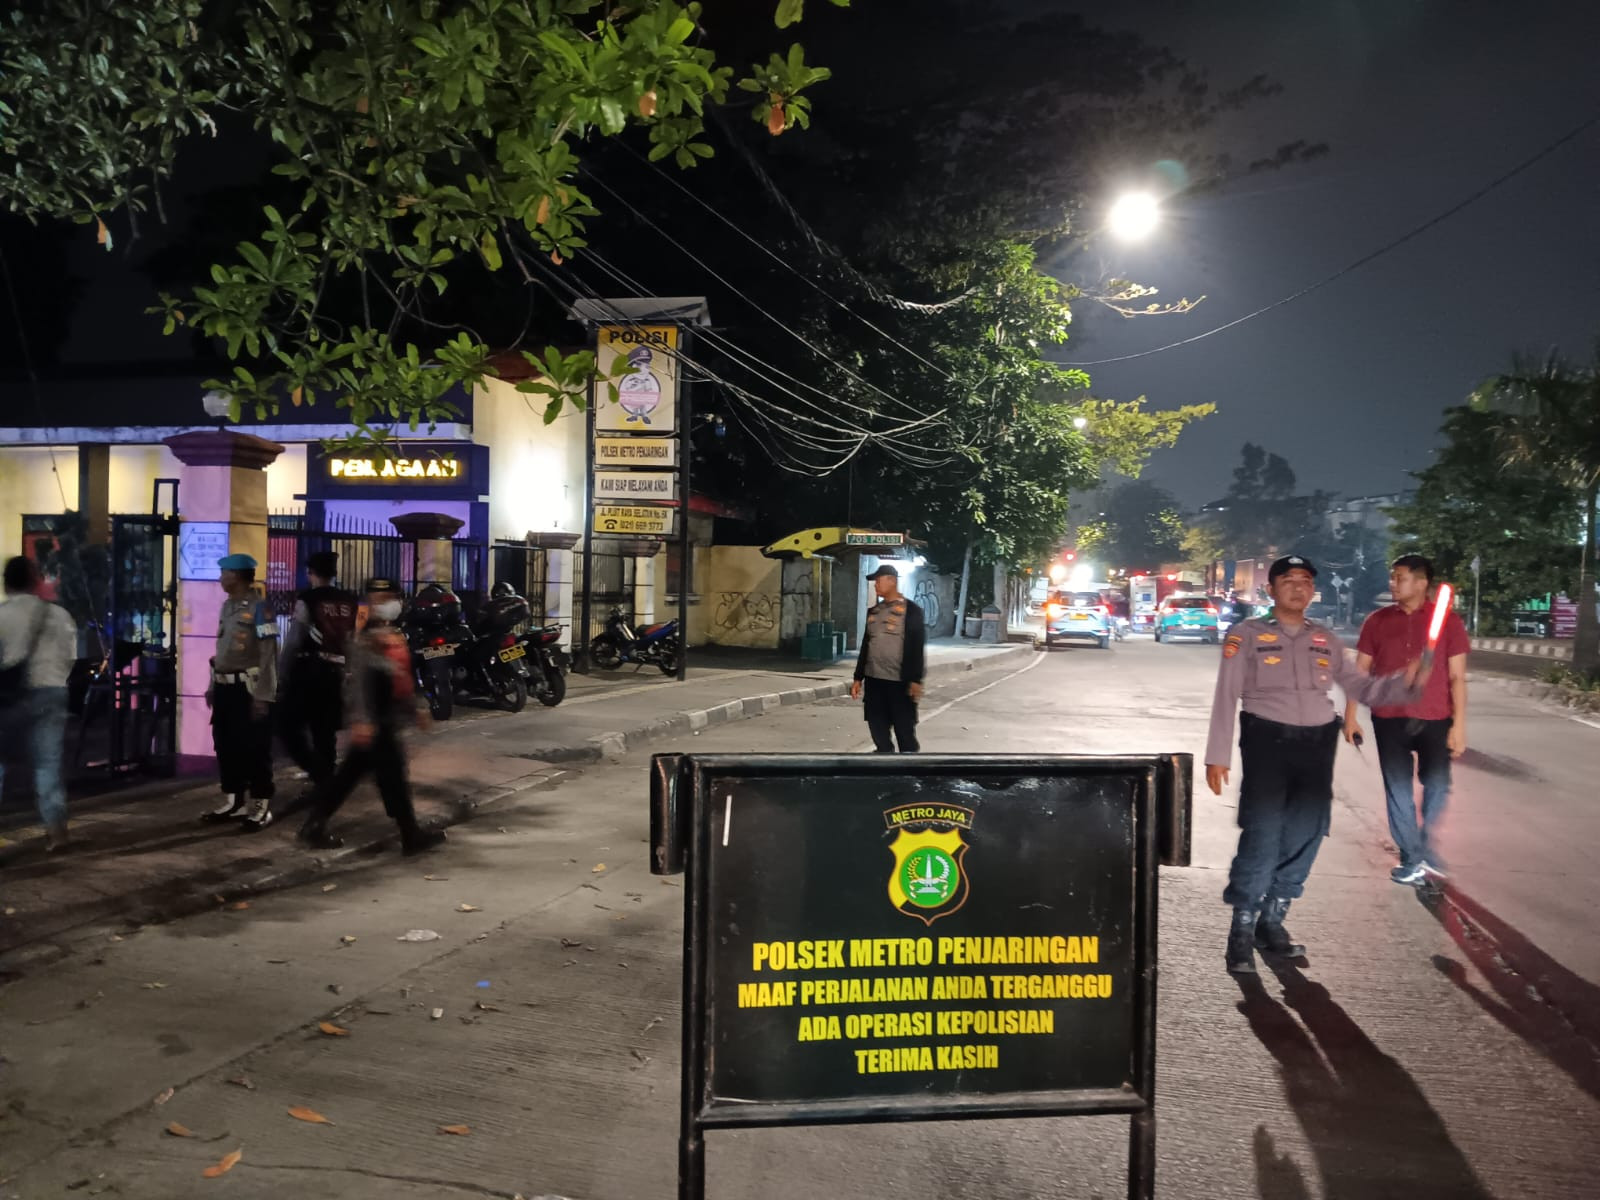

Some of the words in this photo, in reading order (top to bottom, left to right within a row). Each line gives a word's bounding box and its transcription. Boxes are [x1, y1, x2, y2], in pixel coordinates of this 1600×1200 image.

[609, 331, 668, 344] POLISI
[600, 446, 619, 458] POLSEK
[620, 446, 636, 458] METRO
[330, 458, 458, 477] PENAGAAN
[615, 479, 627, 492] SIAP
[850, 535, 867, 544] POS
[871, 535, 899, 544] POLISI
[891, 808, 934, 823] METRO
[937, 808, 966, 823] JAYA
[752, 940, 845, 971] POLSEK
[849, 938, 932, 968] METRO
[937, 935, 1099, 965] PENJARINGAN
[738, 981, 798, 1008] MAAF
[801, 977, 928, 1005] PERJALANAN
[931, 975, 987, 1000] ANDA
[989, 974, 1112, 999] TERGANGGU
[797, 1015, 842, 1042] ADA
[845, 1011, 932, 1040] OPERASI
[936, 1009, 1054, 1035] KEPOLISIAN
[854, 1047, 934, 1074] TERIMA
[937, 1045, 999, 1070] KASIH
